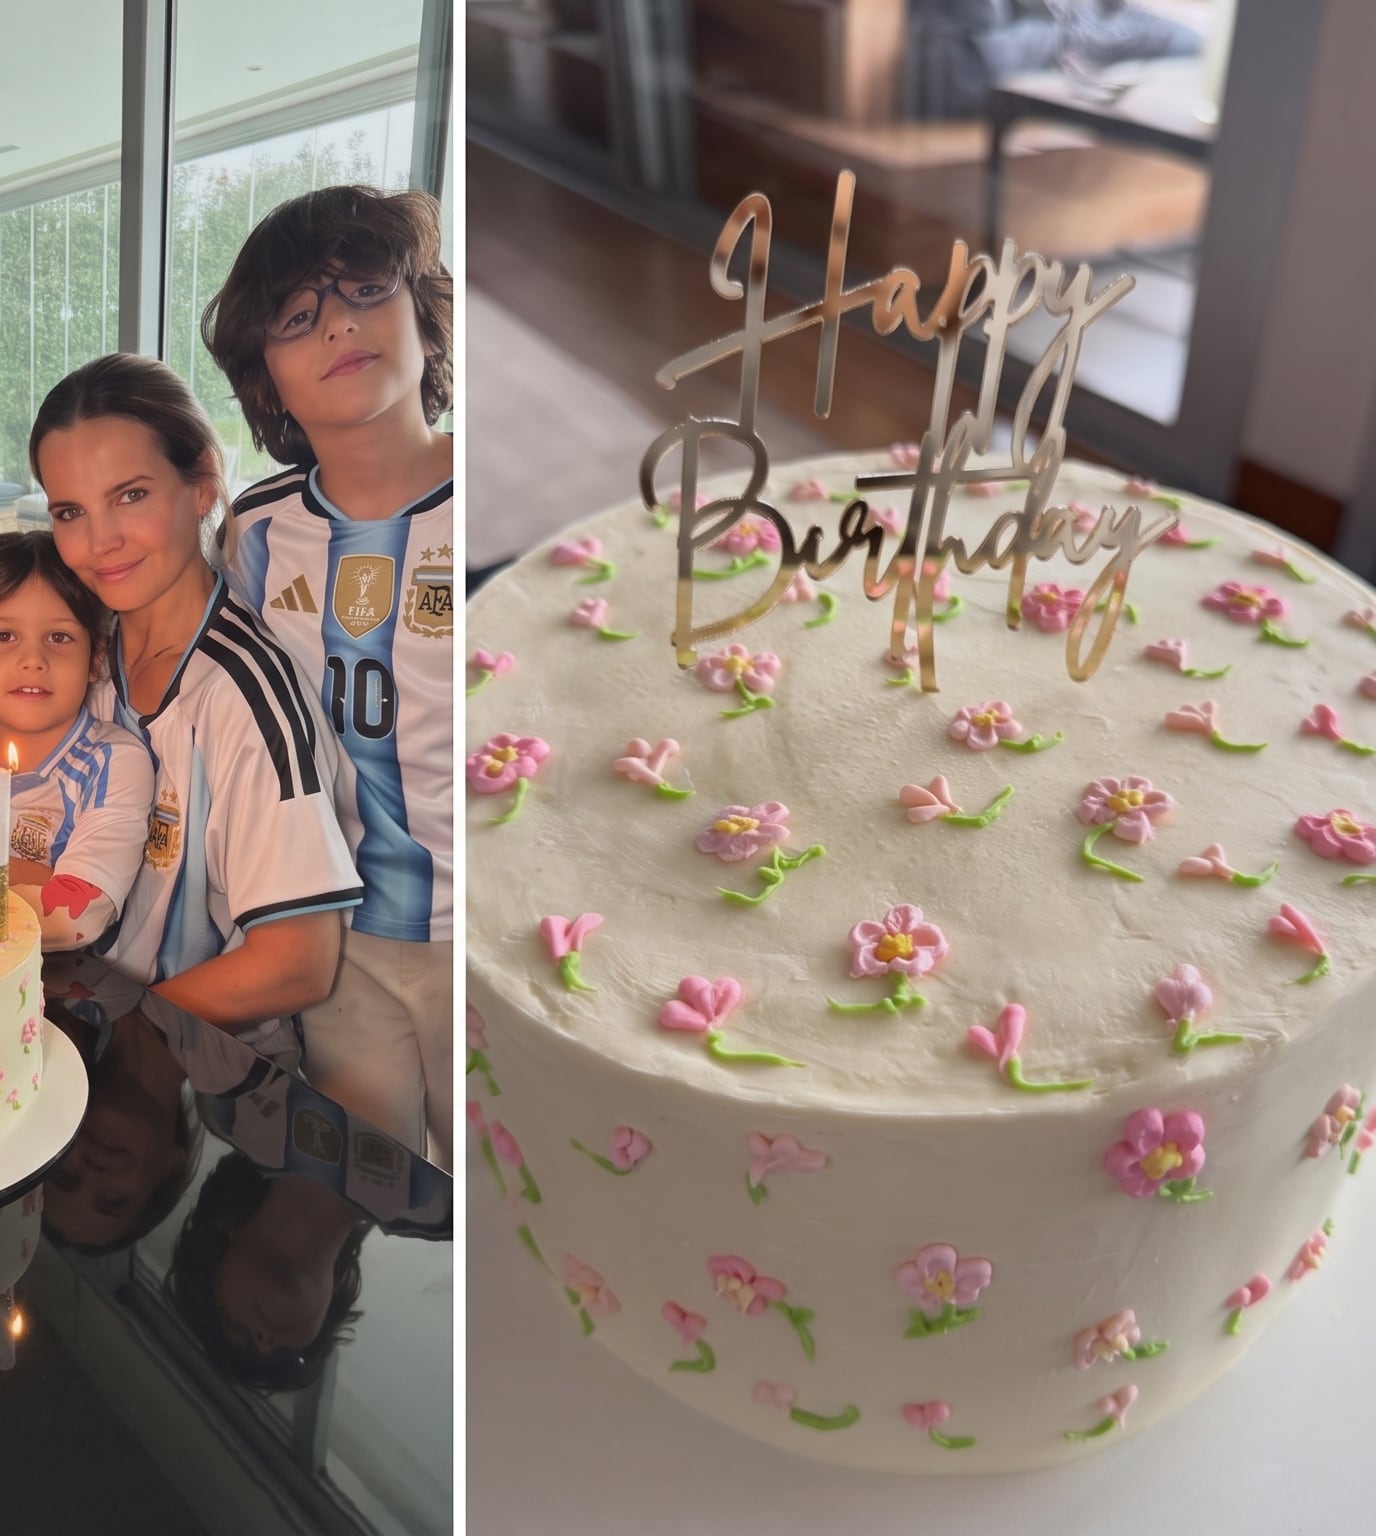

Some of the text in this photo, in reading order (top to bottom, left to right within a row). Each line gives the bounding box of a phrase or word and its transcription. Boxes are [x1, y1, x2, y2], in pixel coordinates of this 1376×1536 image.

[655, 169, 1137, 470] Happy
[639, 412, 1180, 692] Birthday
[348, 606, 375, 617] FIFA
[418, 584, 453, 617] AFA
[326, 655, 395, 740] 10
